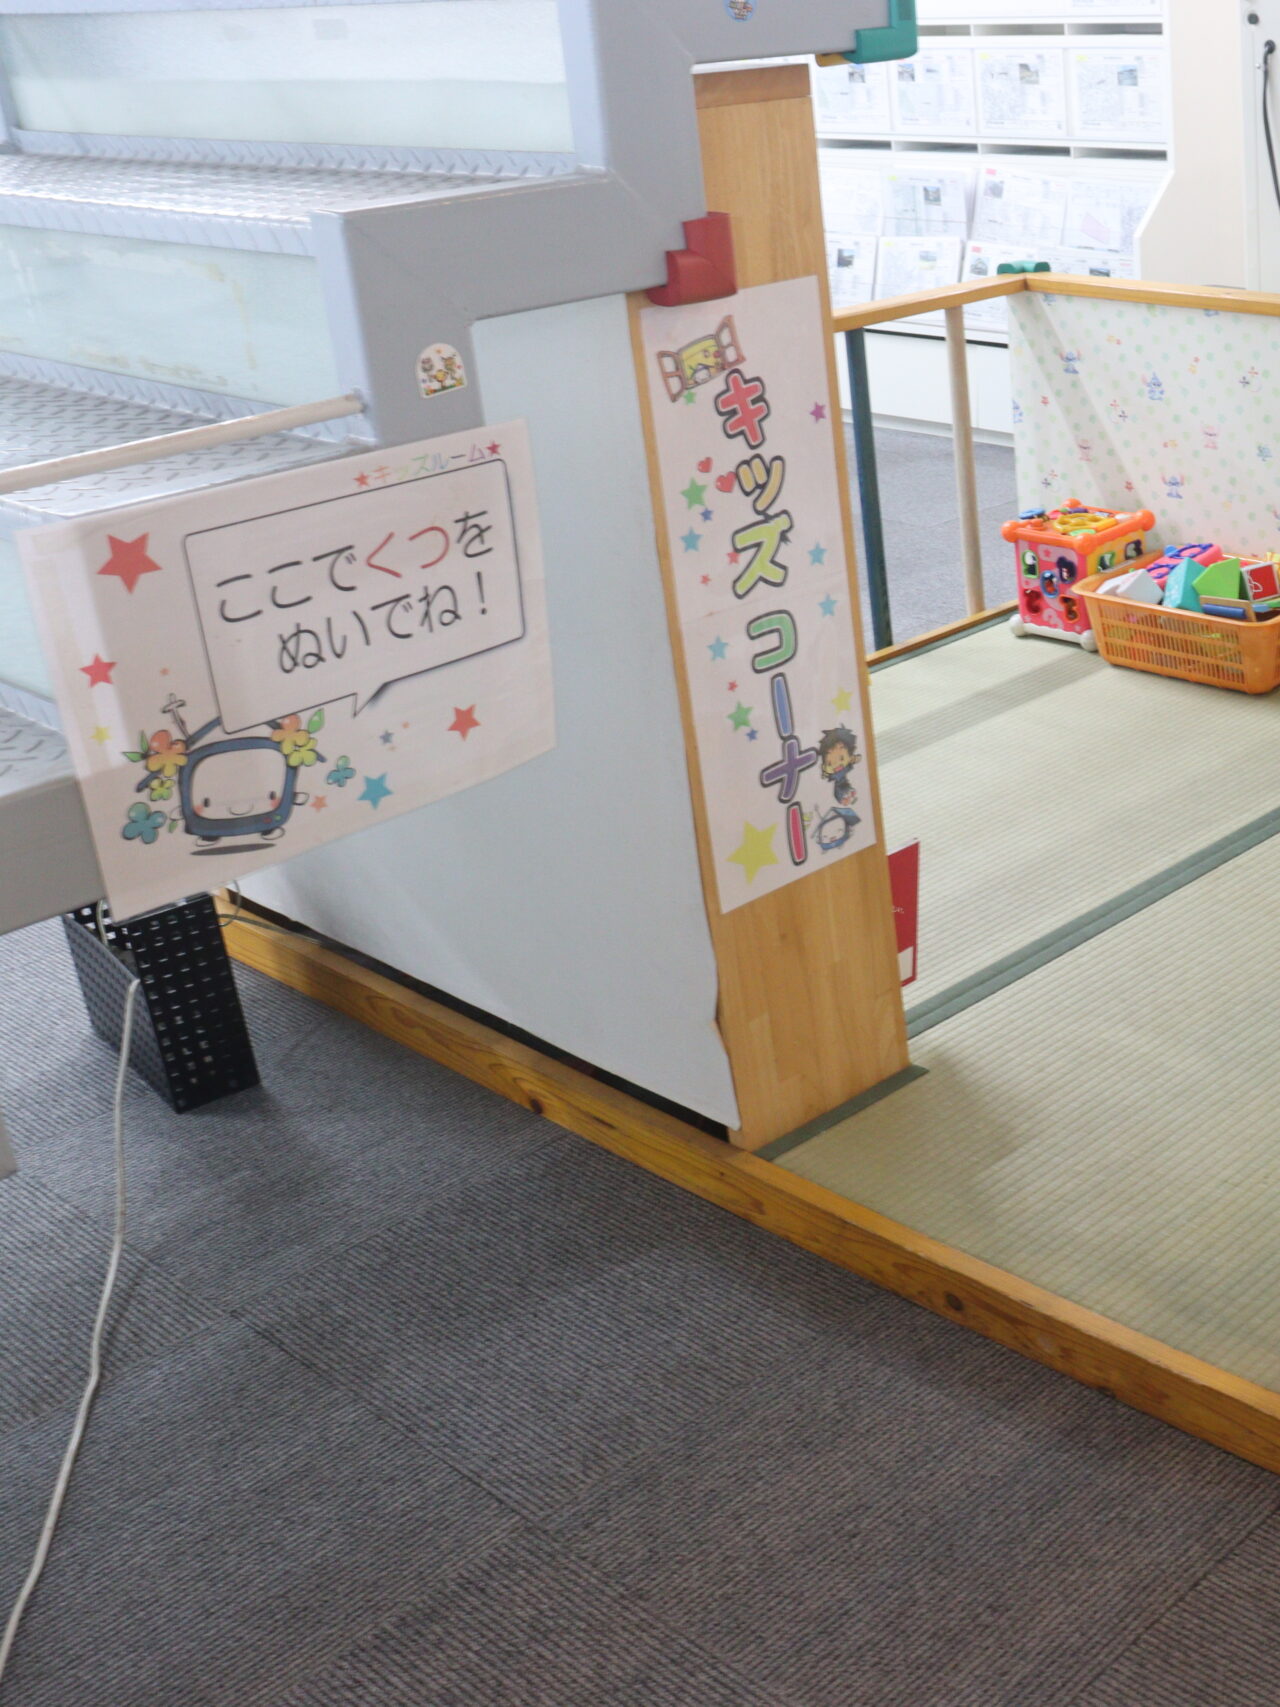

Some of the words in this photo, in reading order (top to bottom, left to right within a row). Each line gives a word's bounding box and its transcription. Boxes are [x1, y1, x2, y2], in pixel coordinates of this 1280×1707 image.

[216, 511, 493, 623] ここでくつを
